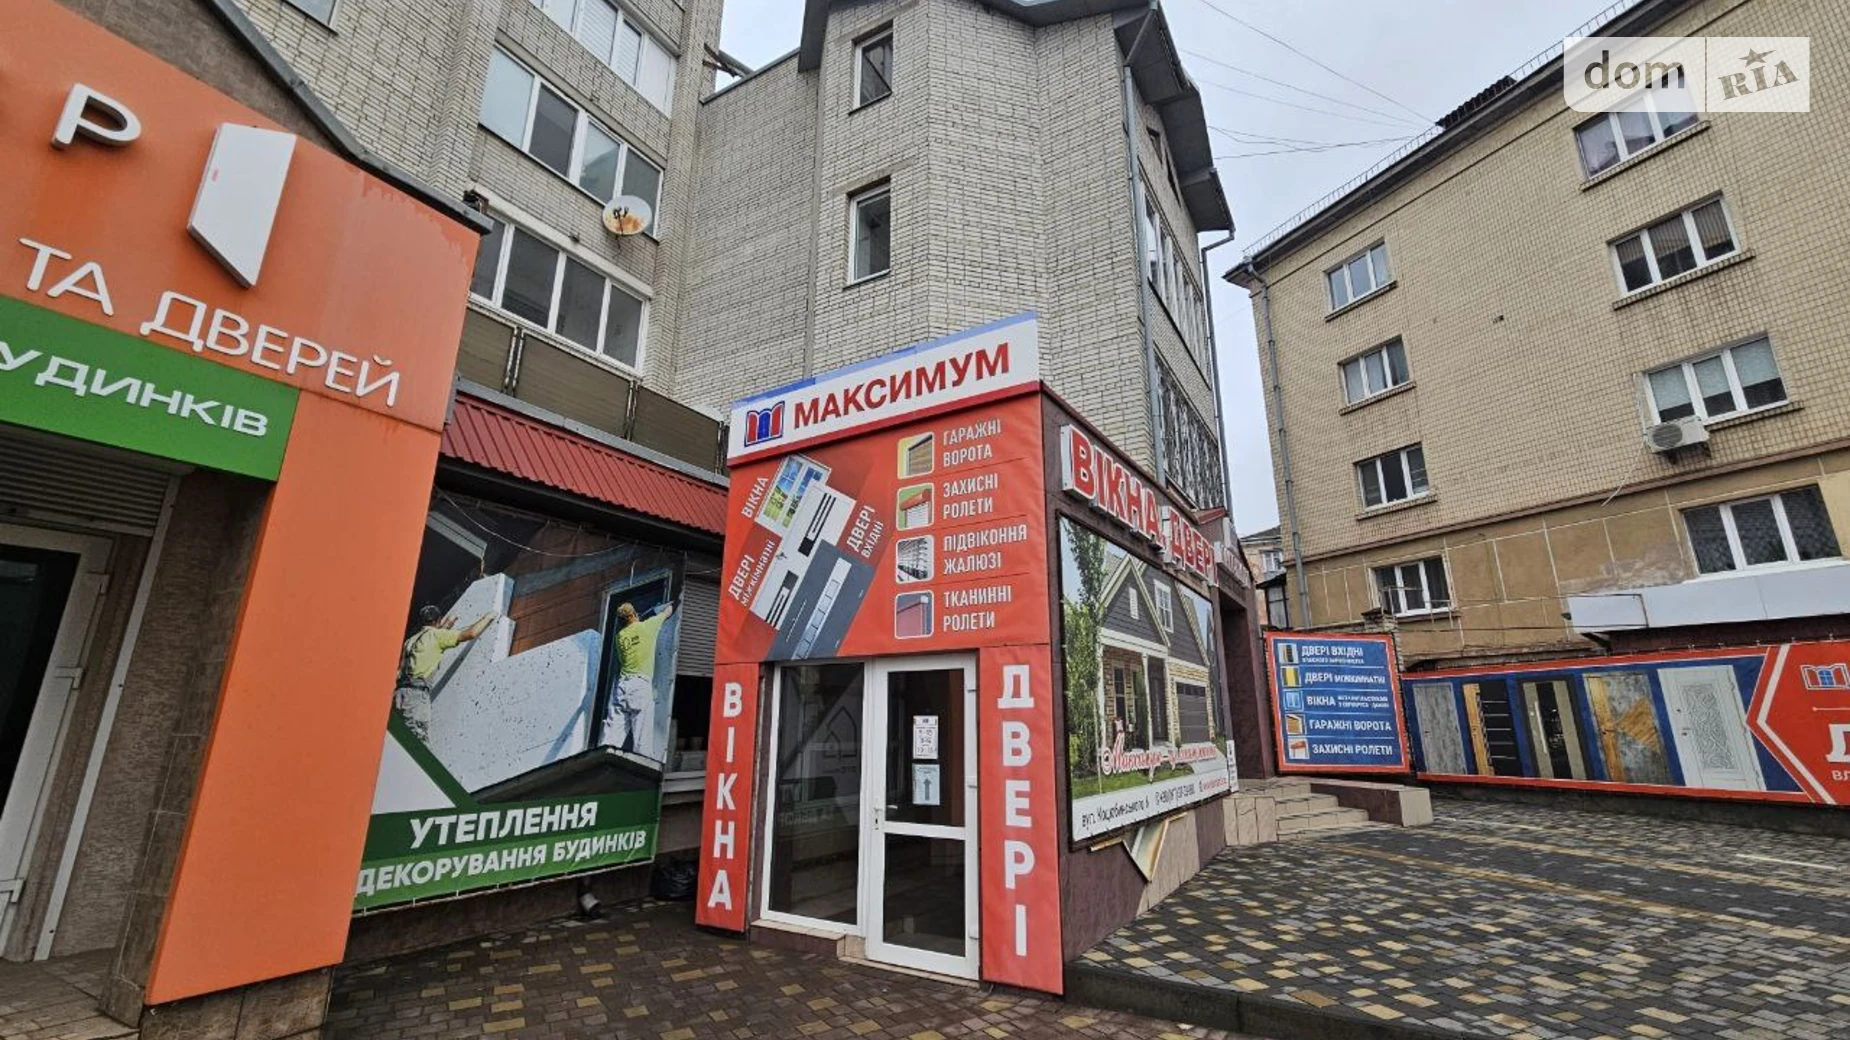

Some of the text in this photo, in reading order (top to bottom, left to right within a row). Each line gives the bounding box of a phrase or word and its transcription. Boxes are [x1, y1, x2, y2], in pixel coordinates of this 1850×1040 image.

[19, 238, 400, 408] ТА ДВЕРЕЙ
[793, 342, 1009, 429] МАКСИМУМ
[943, 418, 1002, 446] ГАРАЖНІ
[943, 444, 993, 467] ВОРОТА
[741, 476, 769, 518] ВІКНА
[943, 473, 998, 498] ЗАХИСНІ
[943, 496, 994, 520] РОЛЕТИ
[846, 505, 875, 552] ДВЕРІ
[943, 523, 1027, 553] ПІДВІКОННЯ
[943, 551, 1002, 576] ЖАЛЮЗІ
[728, 554, 755, 601] ДВЕРІ
[943, 585, 1012, 608] ТКАНИННІ
[943, 612, 995, 632] РОЛЕТИ
[1302, 645, 1364, 658] ДВЕРІ ВХІДНІ
[1305, 672, 1333, 685] ДВЕРІ
[1306, 695, 1336, 707] ВІКНА
[1309, 719, 1392, 731] ГАРАЖНІ ВОРОТА
[1312, 744, 1393, 756] ЗАХИСНІ РОЛЕТИ
[707, 682, 743, 911] ВІКНА
[997, 664, 1035, 956] ДВЕРІ
[409, 801, 598, 849] УТЕПЛЕННЯ
[355, 830, 646, 897] ДЕКОРУВАННЯ БУДИНКІВ
